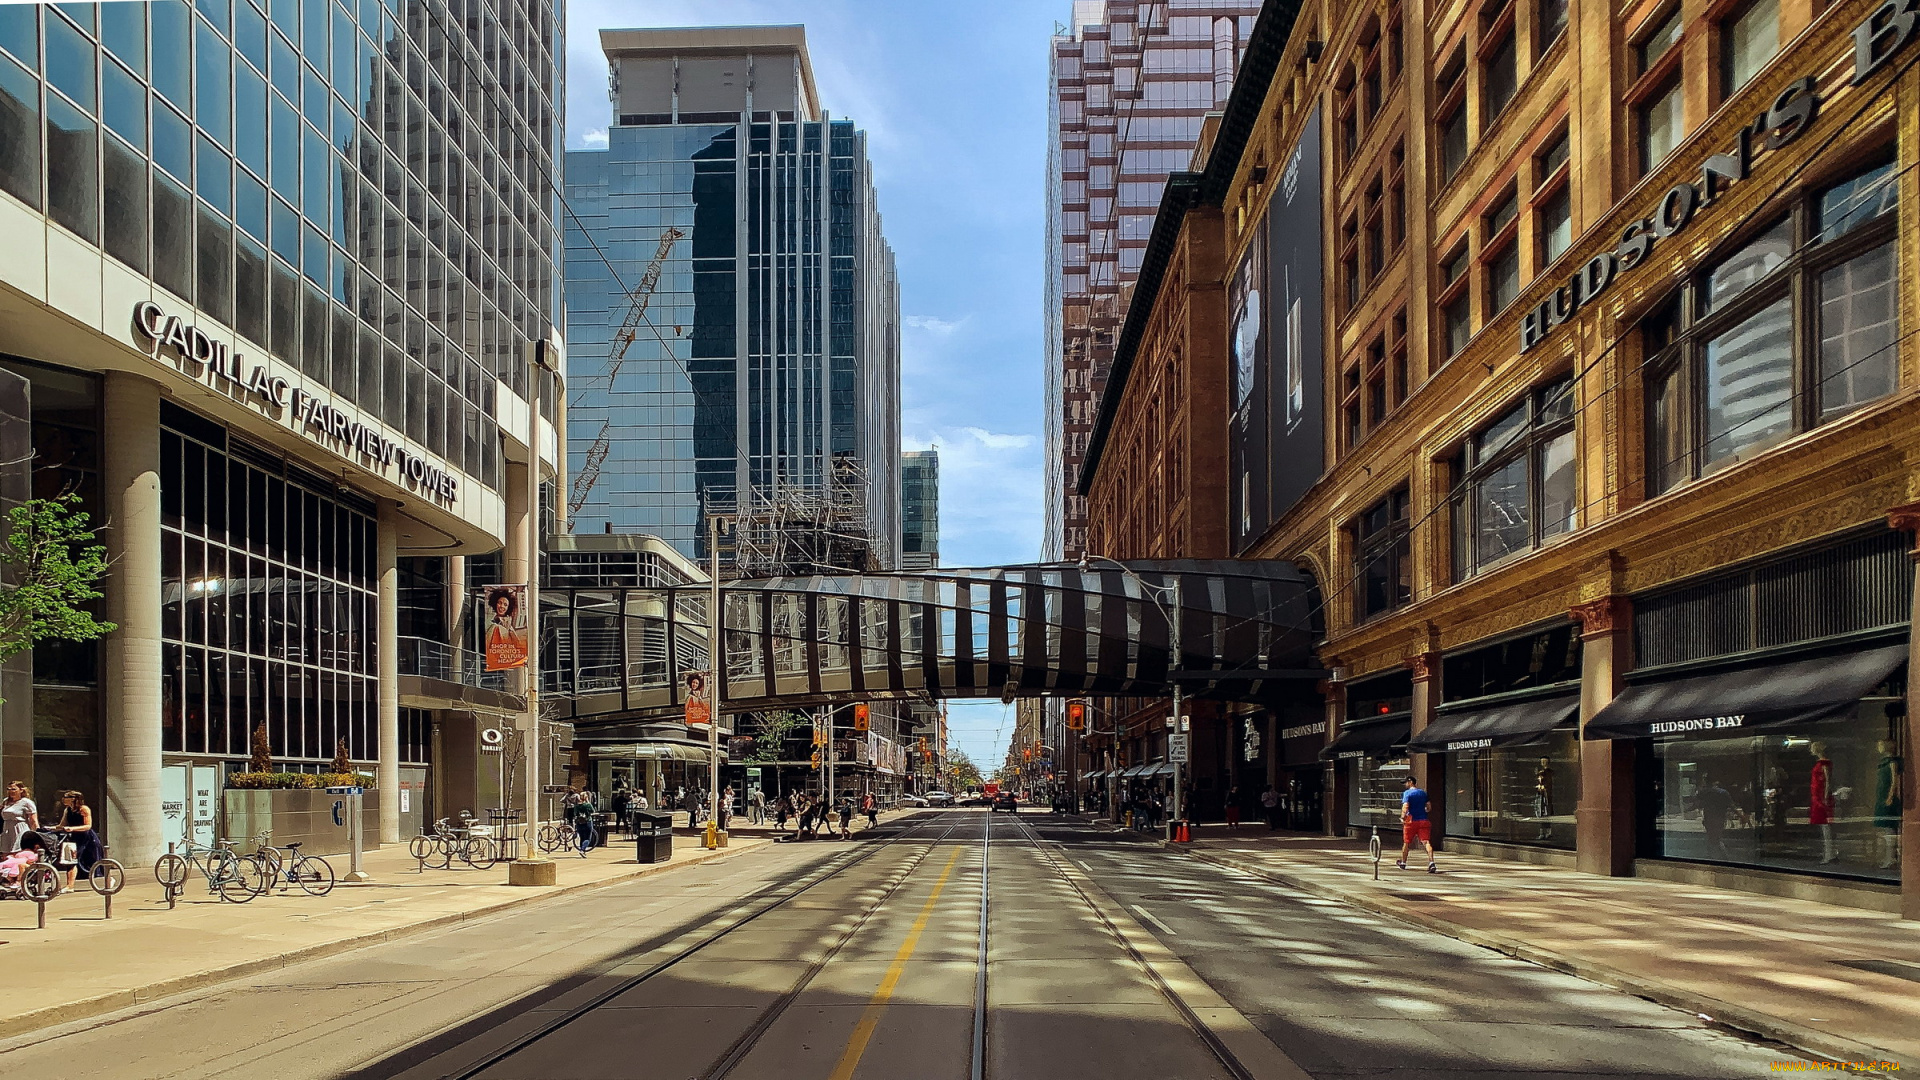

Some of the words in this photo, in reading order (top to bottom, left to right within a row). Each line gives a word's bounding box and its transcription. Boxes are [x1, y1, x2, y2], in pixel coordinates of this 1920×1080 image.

[1519, 77, 1817, 353] HUDSON'S
[133, 301, 290, 408] CADILLAC
[292, 387, 396, 466] FAIRVIEW
[397, 447, 459, 503] TOWER
[1282, 724, 1312, 739] HUDSON'S
[1312, 721, 1326, 734] BAY
[1650, 717, 1713, 734] HUDSON'S
[1715, 714, 1745, 728] BAY
[1447, 740, 1478, 750] HUDSON'S
[1478, 738, 1493, 748] BAY
